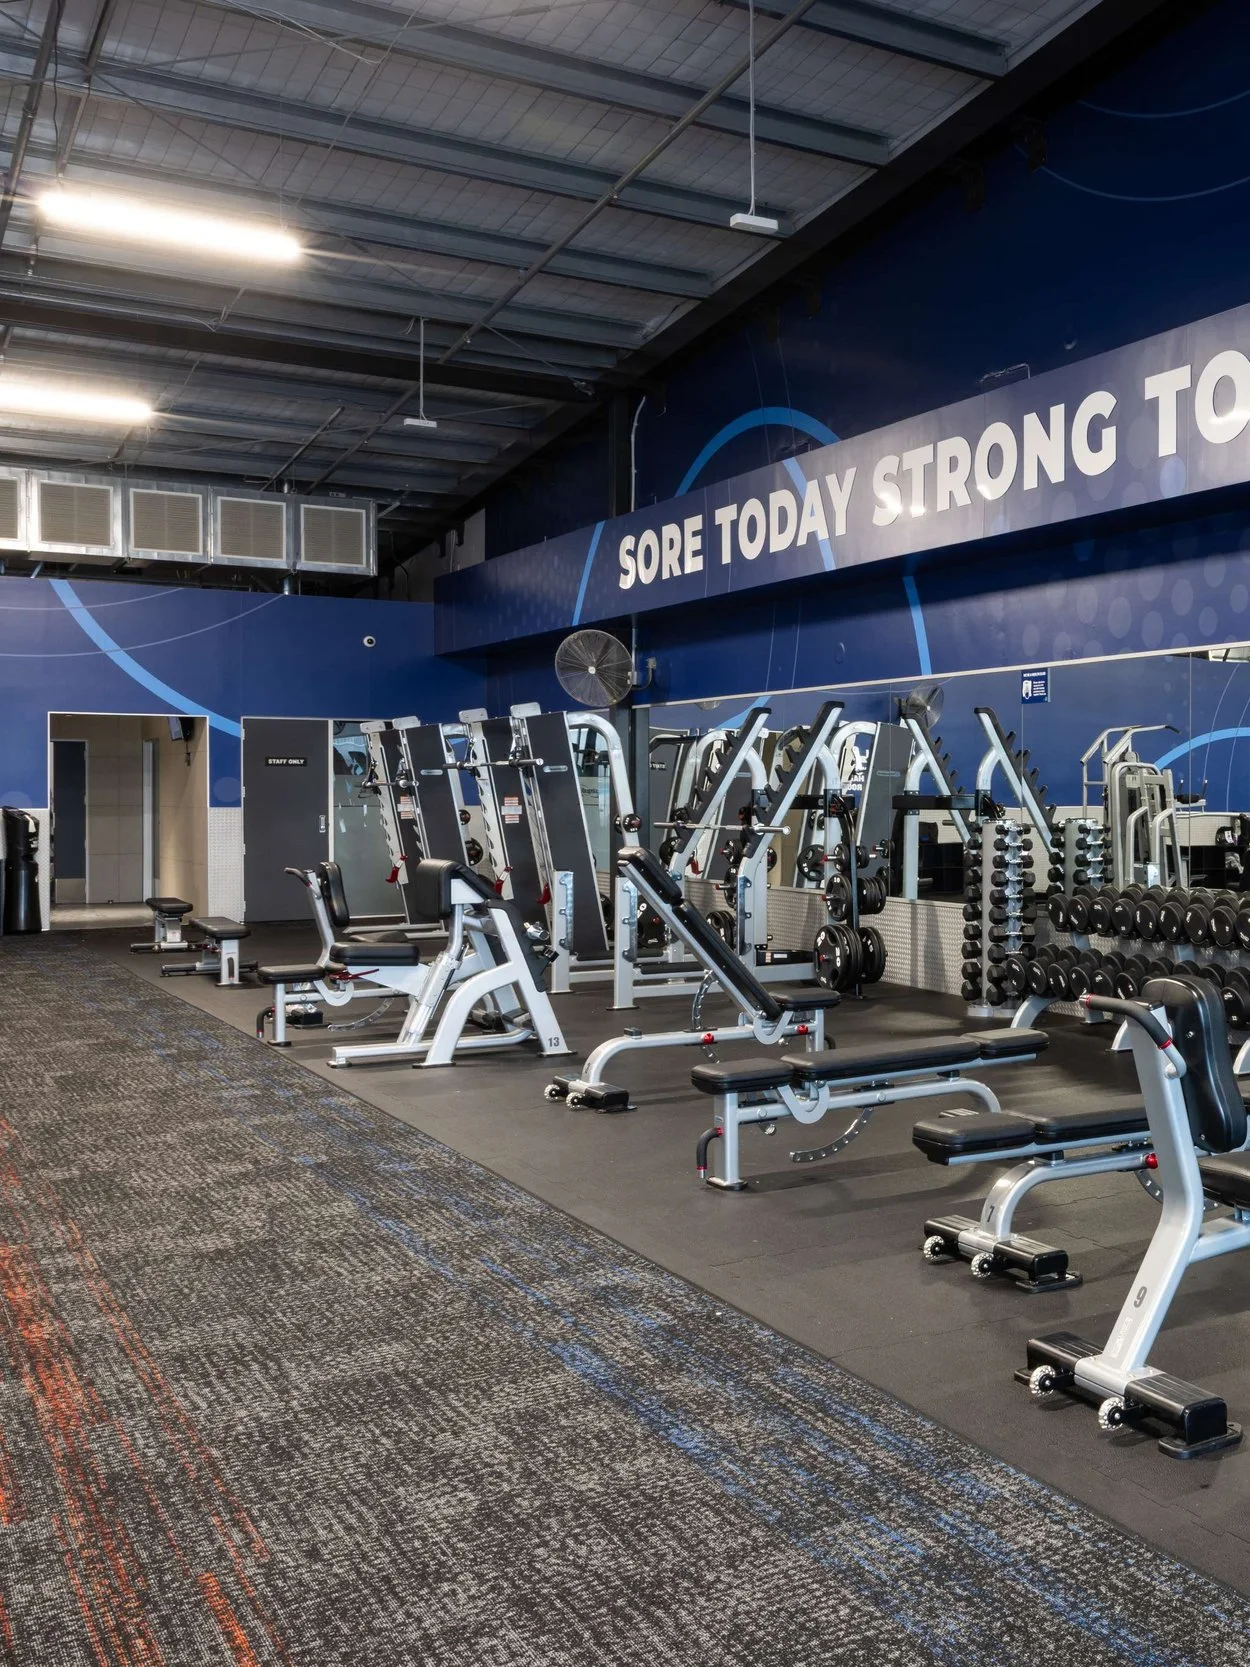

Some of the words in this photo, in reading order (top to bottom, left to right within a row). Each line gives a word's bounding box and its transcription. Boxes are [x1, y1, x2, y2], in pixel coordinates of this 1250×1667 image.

[618, 514, 704, 590] SORE
[715, 466, 857, 565] TODAY
[872, 390, 1117, 526] STRONG
[547, 1036, 560, 1048] 13
[1133, 1285, 1148, 1309] 9
